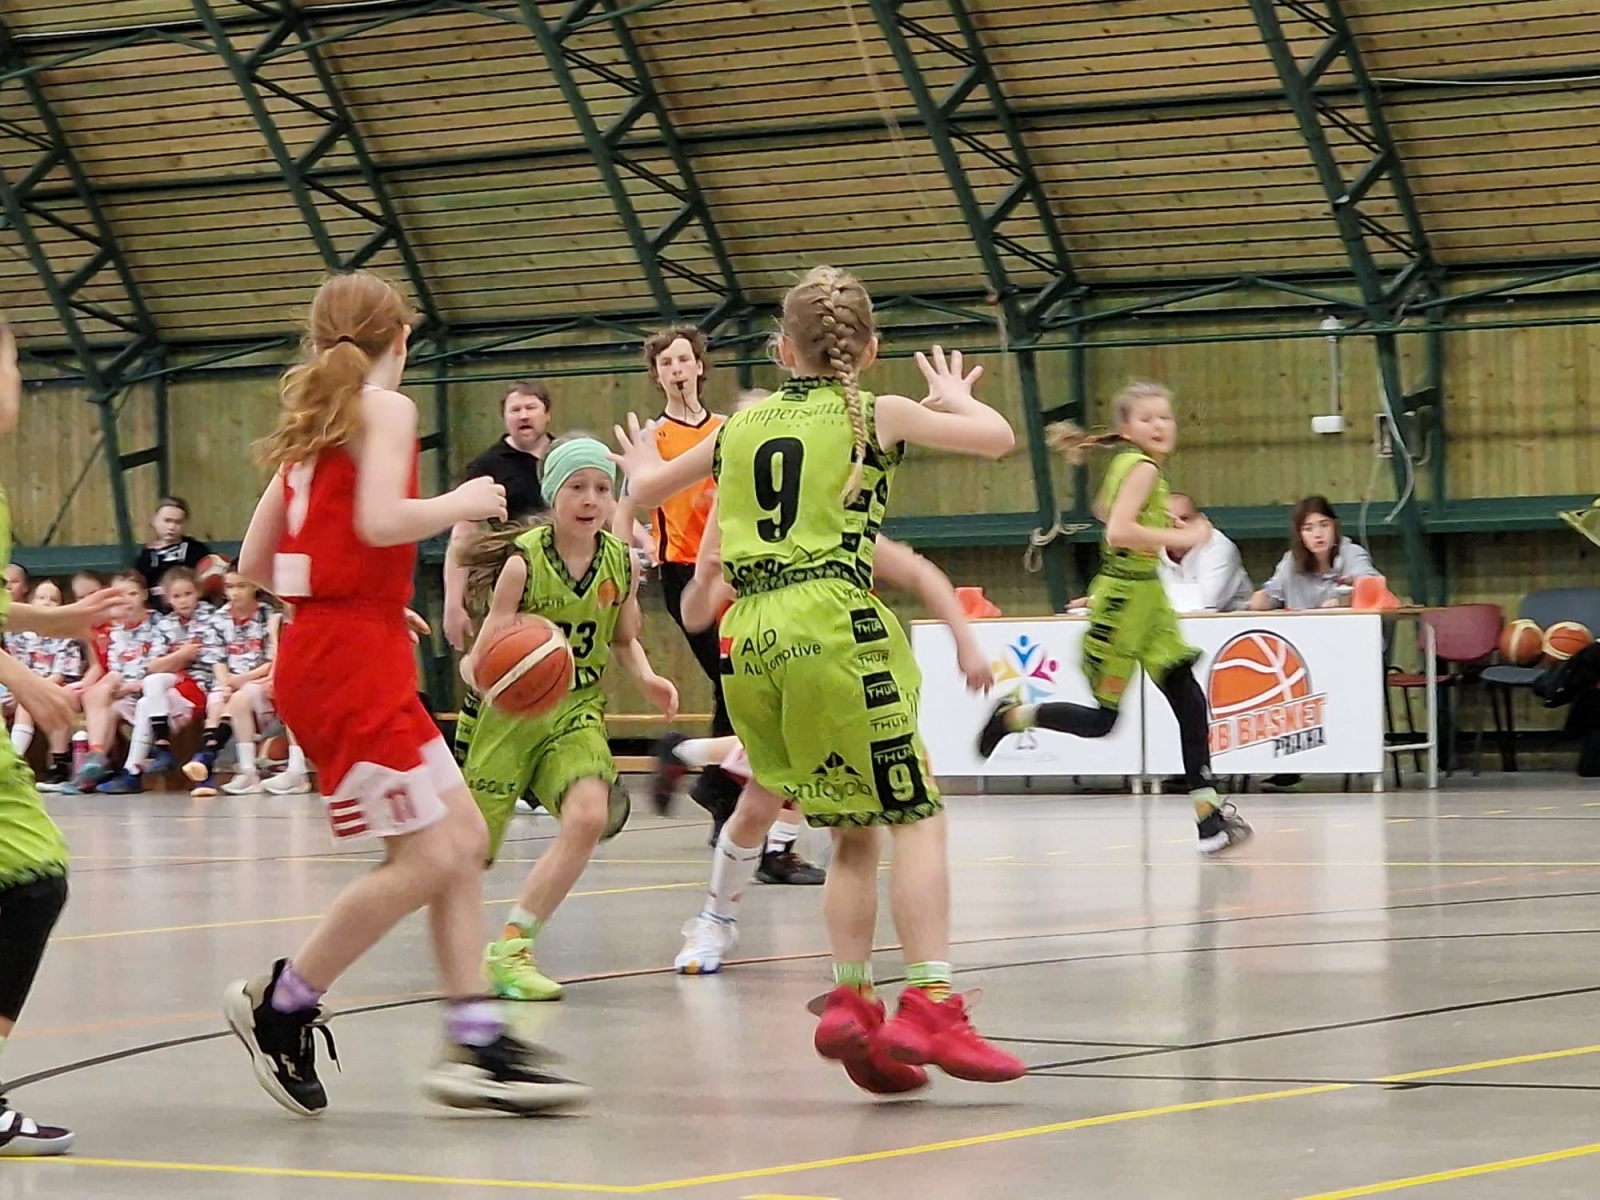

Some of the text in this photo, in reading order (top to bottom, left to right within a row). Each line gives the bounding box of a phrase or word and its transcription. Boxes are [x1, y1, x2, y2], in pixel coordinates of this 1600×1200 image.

[754, 437, 804, 542] 9
[741, 628, 777, 656] ALD
[888, 763, 915, 801] 9
